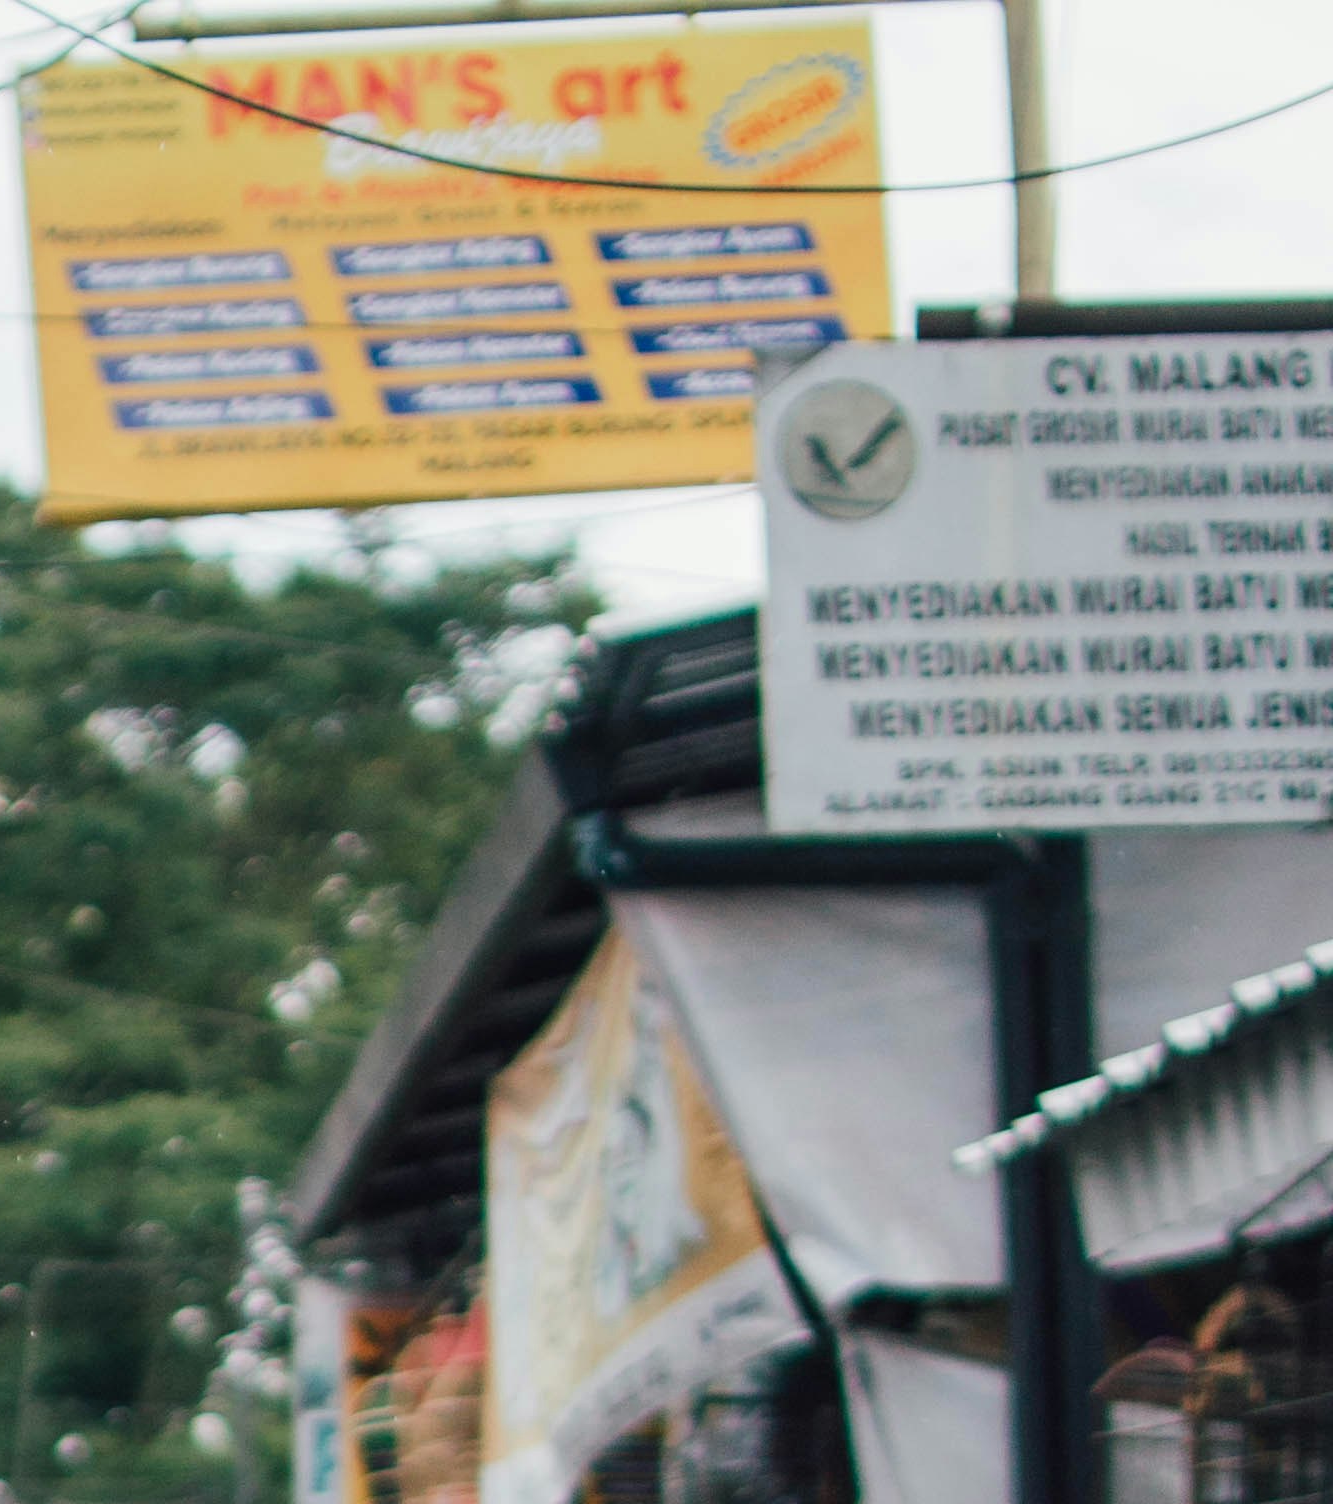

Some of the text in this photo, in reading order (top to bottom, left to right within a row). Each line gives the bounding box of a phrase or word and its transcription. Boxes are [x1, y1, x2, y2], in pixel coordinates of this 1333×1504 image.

[206, 53, 505, 139] MAN'S
[555, 50, 690, 119] art
[1129, 350, 1313, 392] MALANG
[807, 580, 1058, 624] MENYEDIAKAN
[1072, 575, 1180, 614] MURAI
[1193, 573, 1281, 611] BATU
[816, 639, 1068, 681] MENYEDIAKAN
[1080, 635, 1189, 674] MURAI
[1203, 632, 1291, 672] BATU
[850, 699, 1102, 738] MENYEDIAKAN
